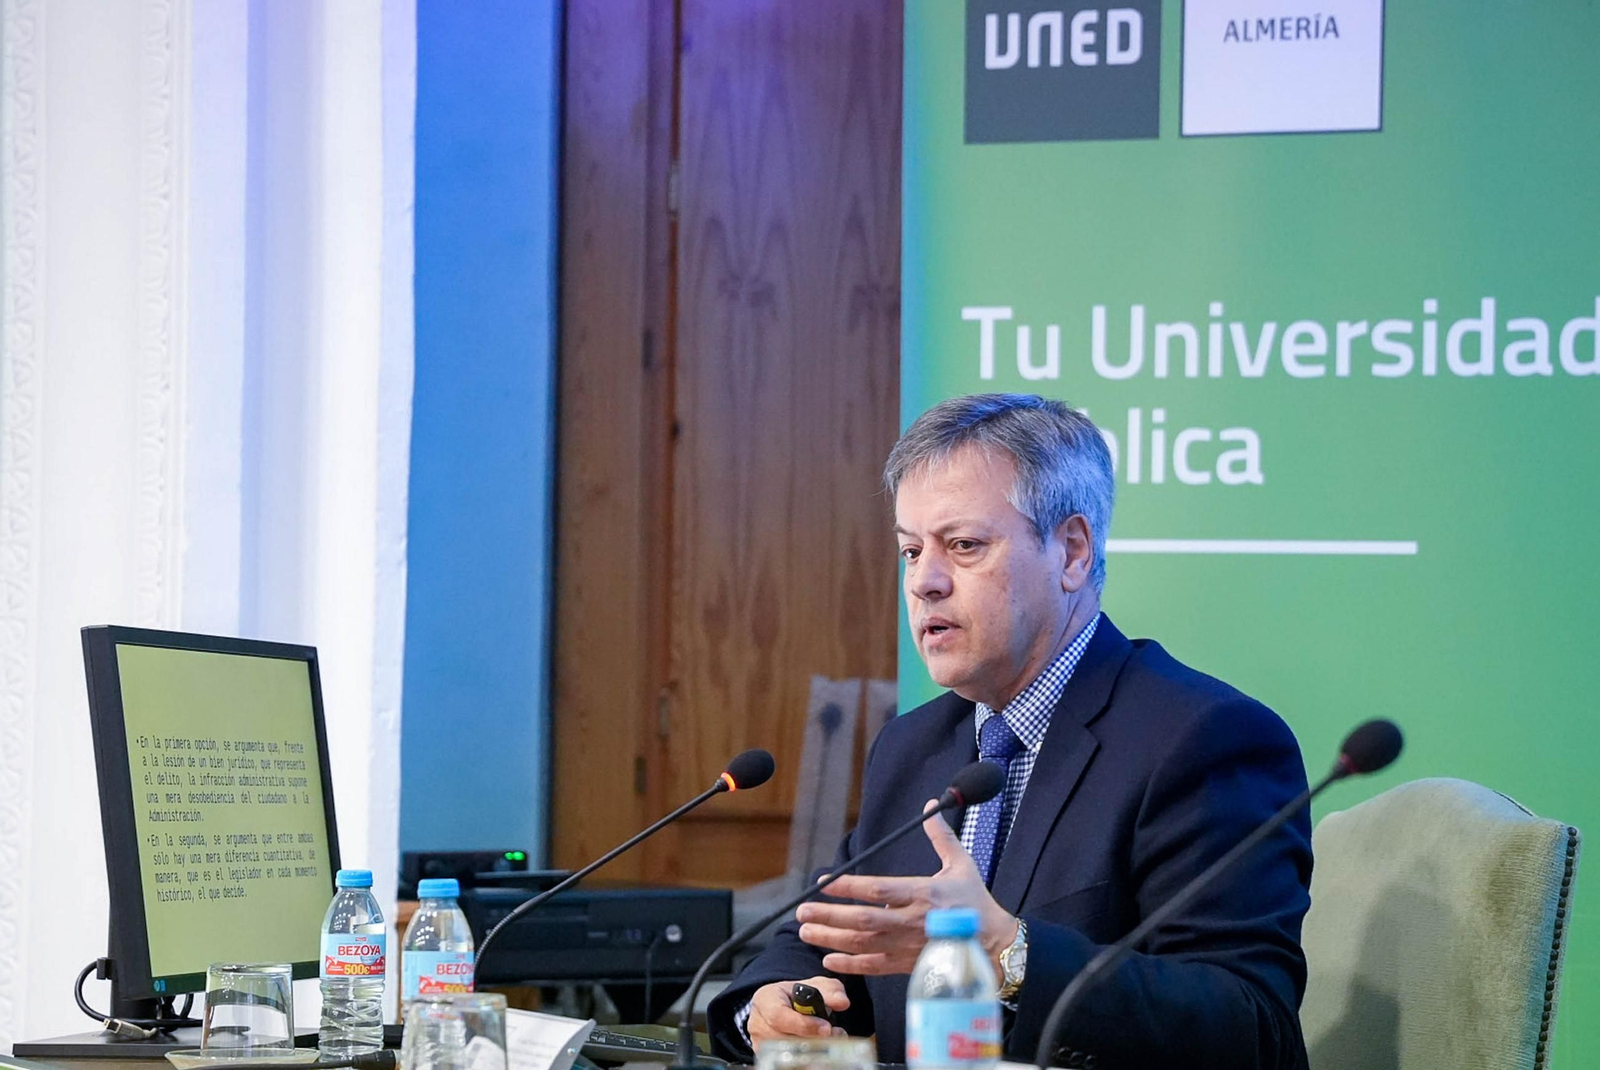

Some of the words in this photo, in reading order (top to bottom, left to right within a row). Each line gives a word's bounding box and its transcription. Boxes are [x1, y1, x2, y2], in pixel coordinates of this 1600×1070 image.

[1224, 15, 1340, 43] ALMERÍA
[984, 8, 1143, 69] UNED
[962, 305, 1061, 380] Tu
[1091, 297, 1600, 379] Universidad
[140, 736, 148, 748] En
[153, 735, 161, 748] la
[165, 738, 191, 750] primera
[224, 741, 230, 750] se
[234, 740, 264, 754] argumenta
[285, 740, 303, 753] frente
[143, 755, 147, 766] a
[151, 754, 158, 766] la
[162, 754, 185, 767] lesión
[188, 755, 195, 767] de
[199, 757, 206, 767] un
[210, 755, 224, 768] bien
[261, 759, 271, 770] que
[274, 759, 305, 771] representa
[145, 772, 152, 785] el
[157, 773, 183, 787] delito,
[188, 772, 196, 785] la
[200, 772, 235, 786] infracción
[239, 775, 285, 786] administrativa
[288, 776, 307, 788] supone
[147, 793, 159, 803] una
[166, 793, 181, 803] mera
[188, 792, 235, 803] desobediencia
[241, 792, 252, 803] del
[258, 792, 287, 803] ciudadano
[293, 793, 297, 803] a
[304, 791, 309, 803] la
[151, 834, 159, 846] En
[165, 833, 173, 846] la
[179, 834, 207, 849] segunda,
[214, 834, 221, 845] se
[226, 833, 257, 847] argumenta
[262, 834, 272, 846] que
[277, 833, 293, 843] entre
[174, 852, 185, 867] hay
[190, 853, 201, 864] una
[206, 852, 221, 863] mera
[225, 850, 259, 863] diferencia
[309, 849, 315, 860] de
[187, 871, 198, 885] que
[204, 871, 211, 881] es
[216, 868, 224, 880] el
[228, 867, 261, 882] legislador
[267, 868, 274, 877] en
[278, 866, 291, 877] cada
[295, 866, 317, 877] momento
[198, 886, 206, 899] el
[209, 889, 220, 901] que
[338, 945, 380, 956] BEZOYA
[437, 963, 474, 975] BEZO
